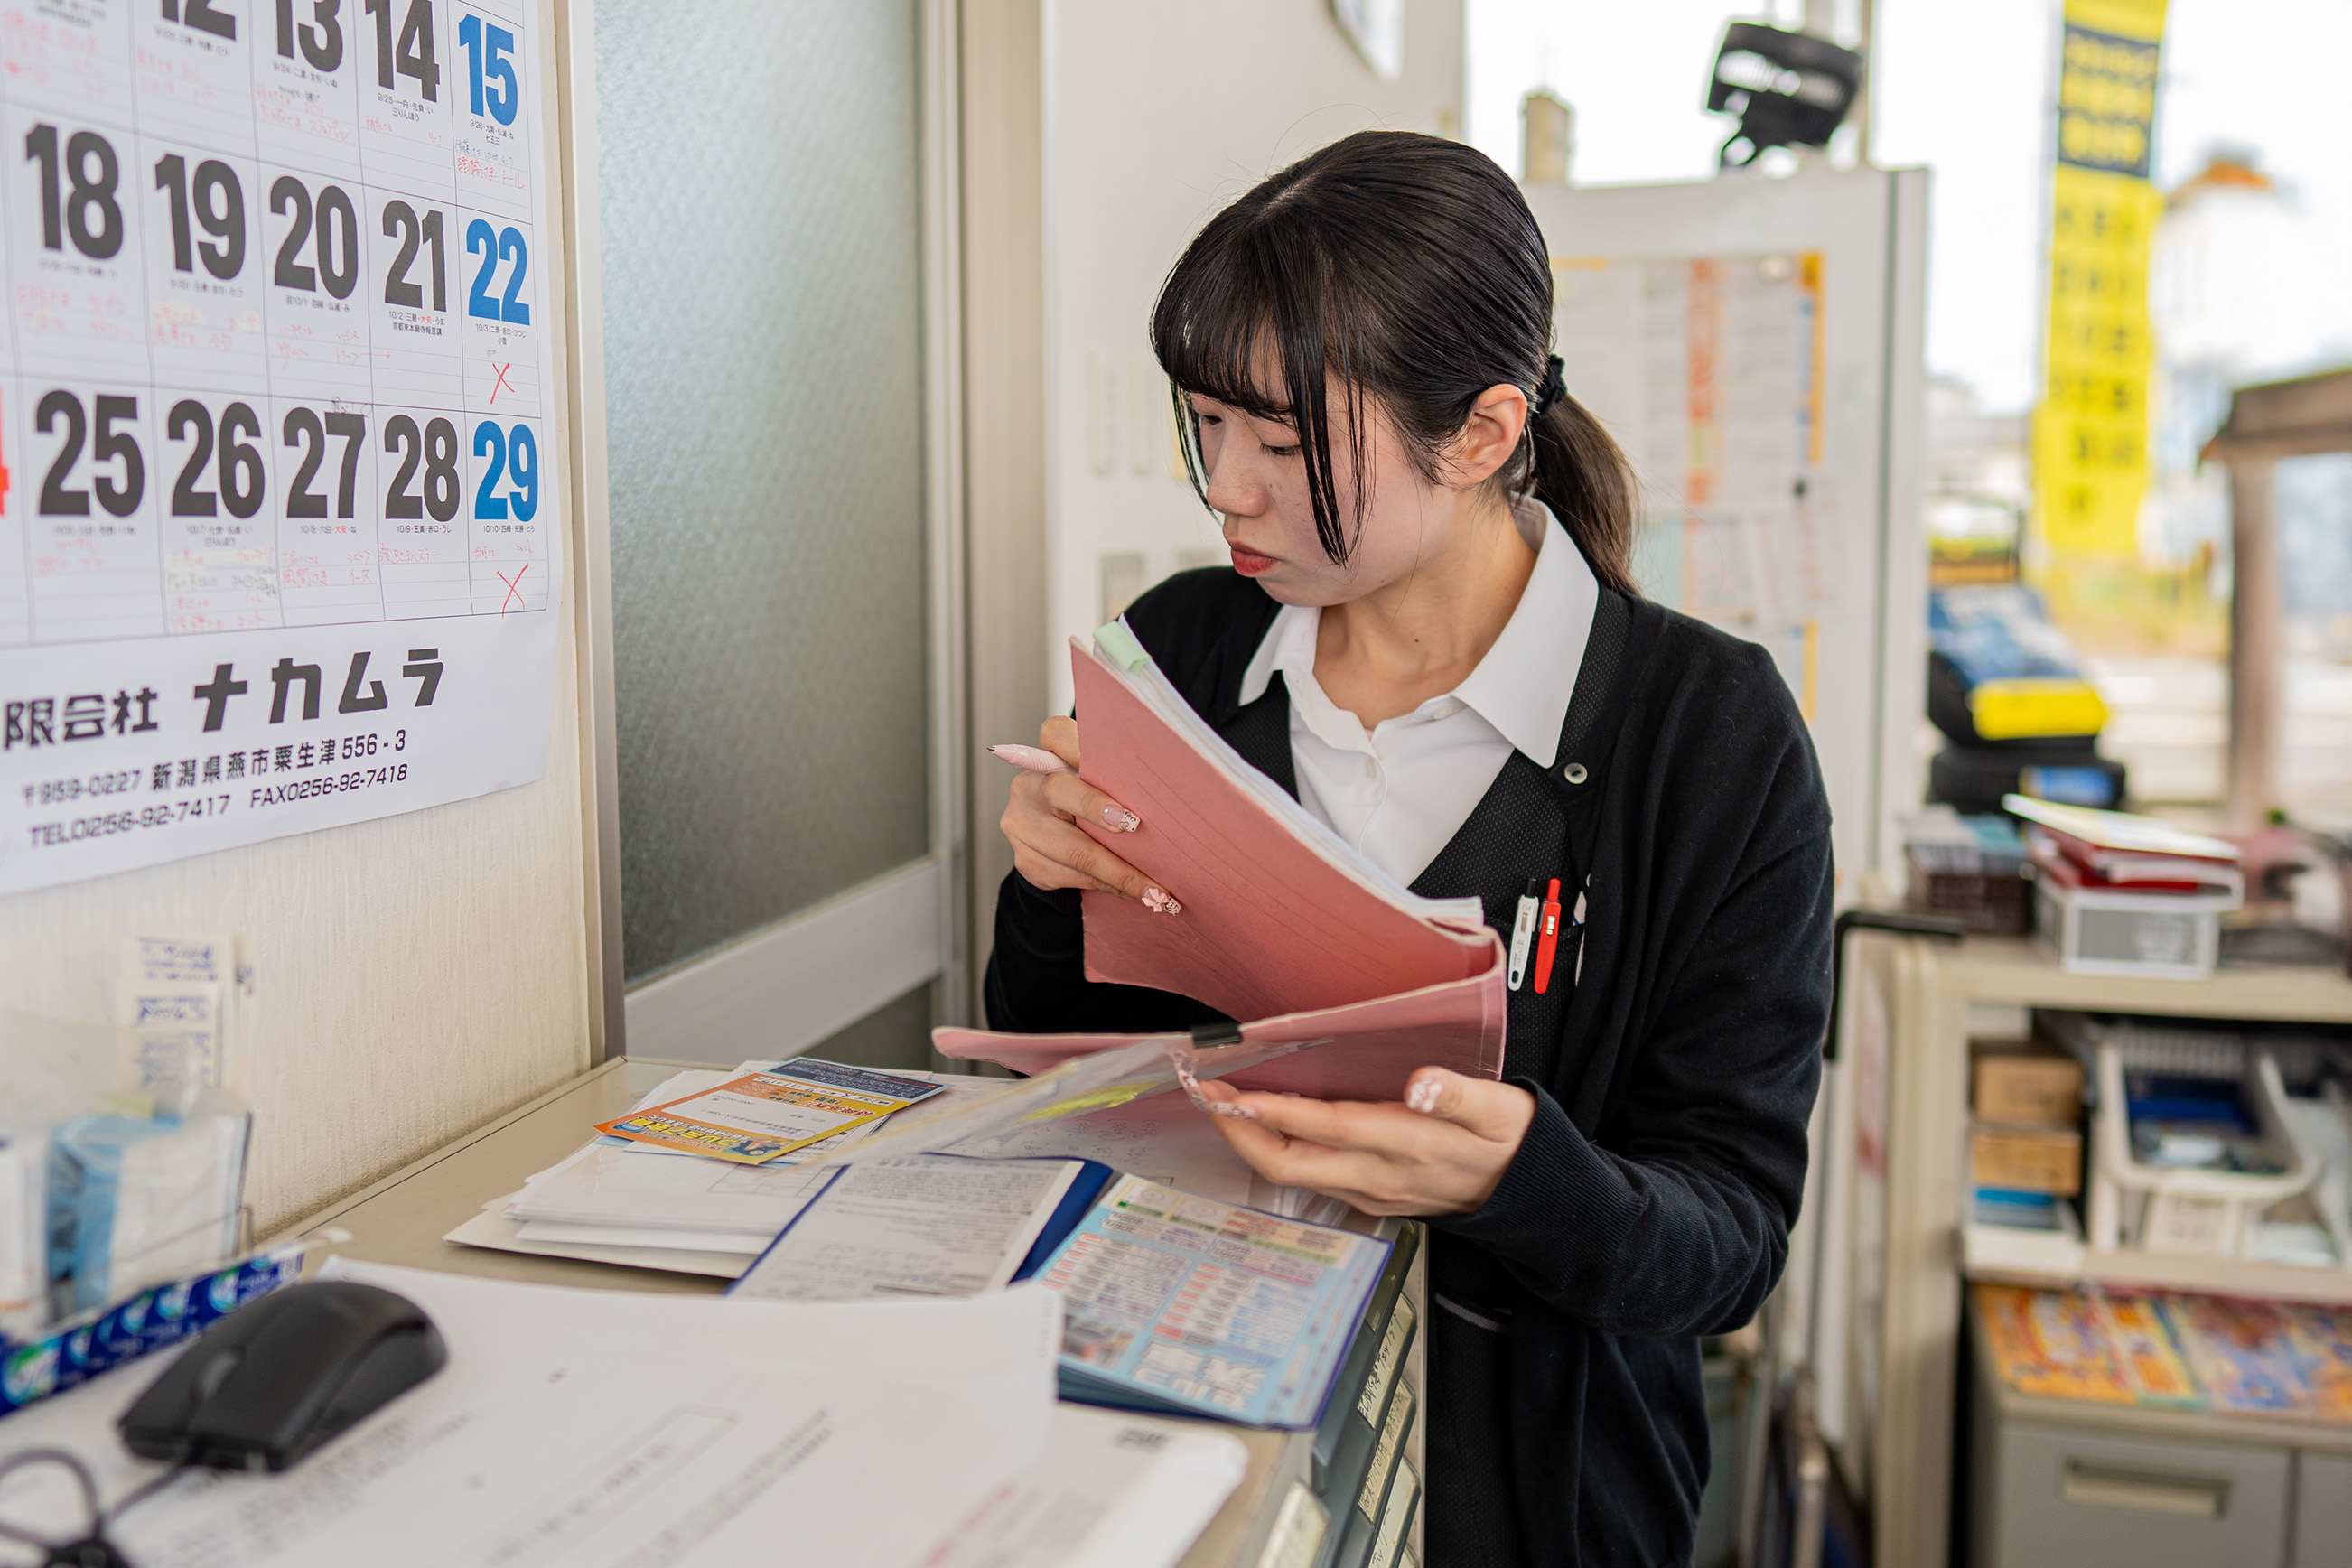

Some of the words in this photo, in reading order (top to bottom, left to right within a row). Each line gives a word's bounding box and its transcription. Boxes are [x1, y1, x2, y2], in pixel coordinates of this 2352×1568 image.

[458, 14, 519, 127] 15
[26, 125, 123, 260] 18
[155, 154, 245, 280] 19
[270, 176, 359, 300] 20
[382, 200, 446, 312] 21
[466, 219, 532, 327] 22
[36, 390, 145, 518] 25
[168, 399, 266, 519] 26
[283, 407, 366, 519] 27
[384, 415, 461, 523] 28
[473, 420, 540, 524] 29
[193, 648, 445, 733] ナカムラ
[249, 762, 409, 810] FAX0256-92-7418
